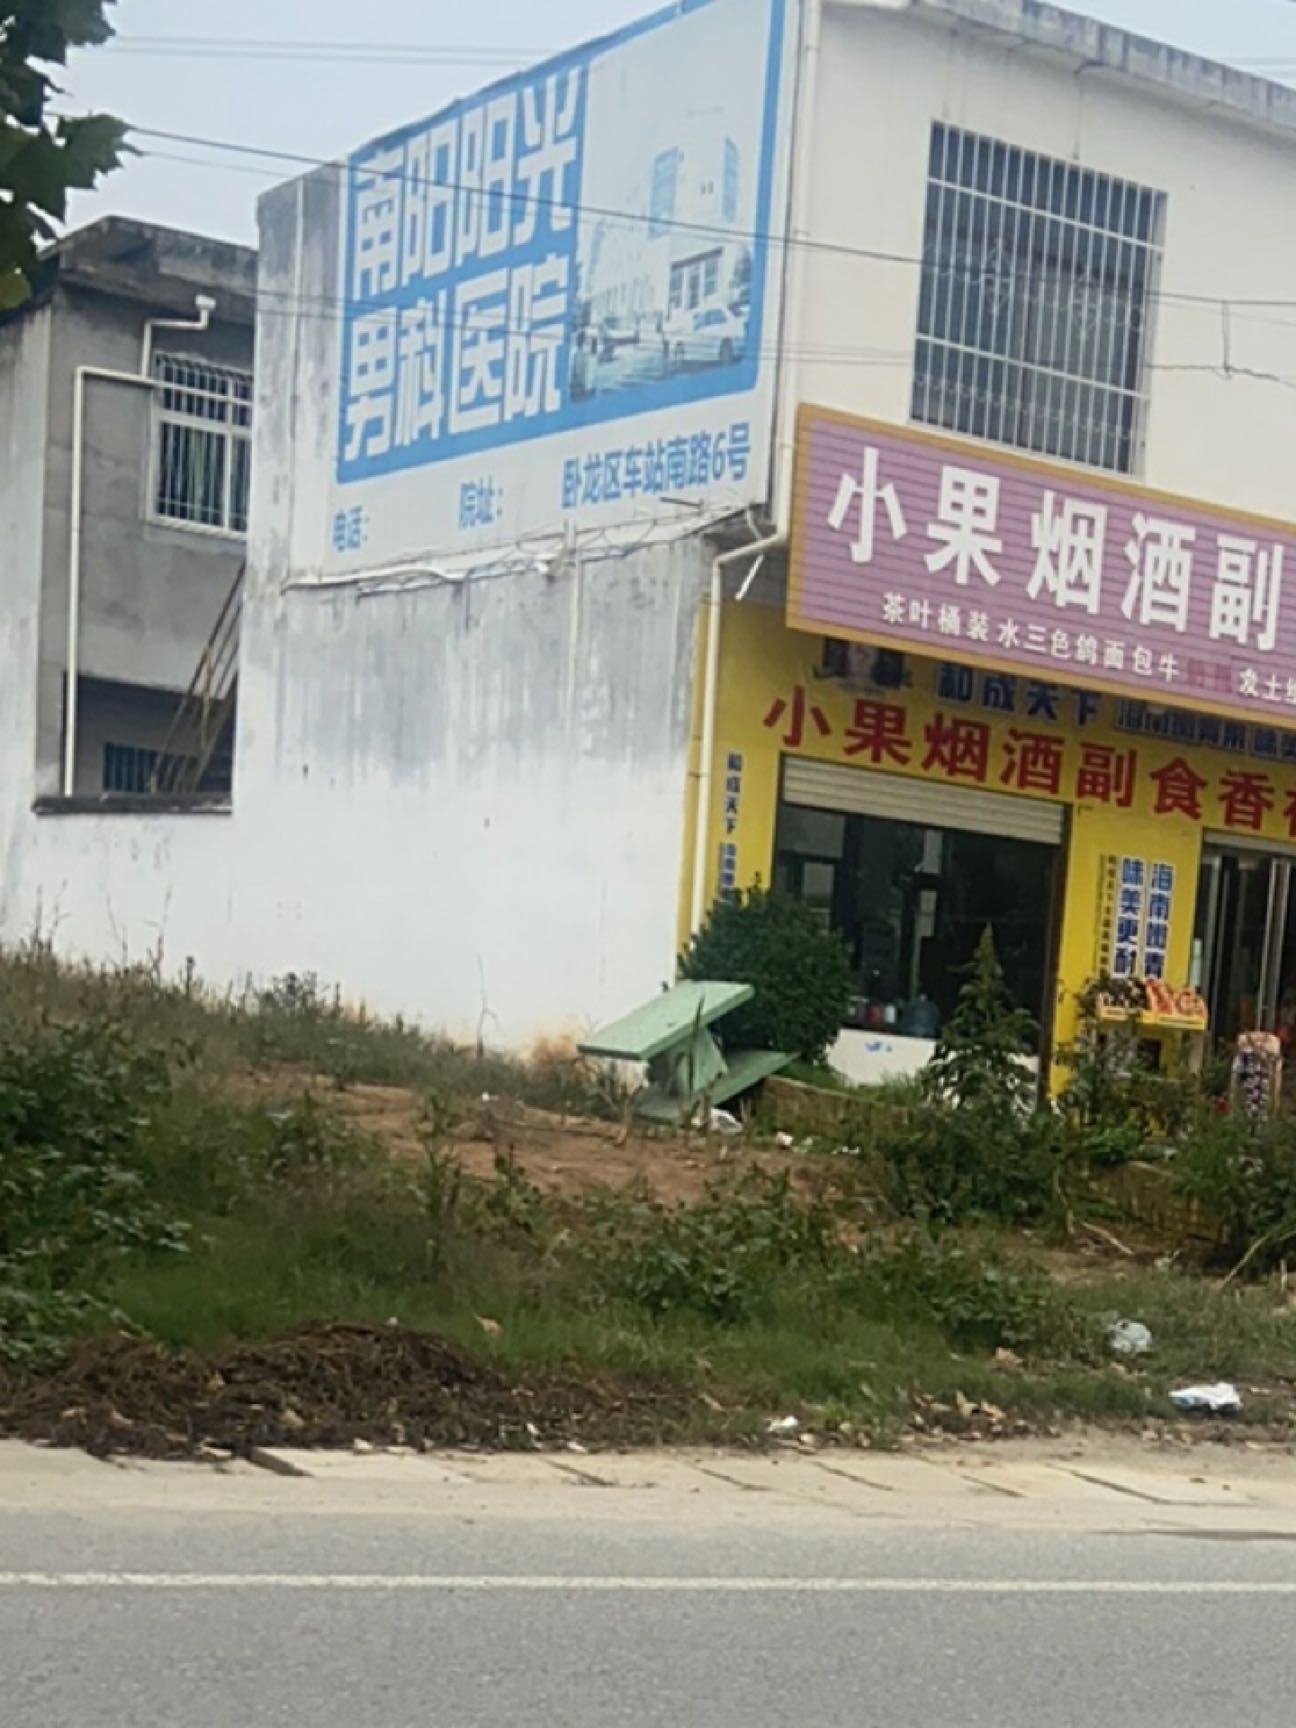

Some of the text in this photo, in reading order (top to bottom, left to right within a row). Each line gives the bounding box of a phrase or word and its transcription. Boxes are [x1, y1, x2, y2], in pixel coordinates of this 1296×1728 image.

[343, 254, 572, 461] 男科医院
[561, 422, 751, 509] 卧龙区车站南路6号
